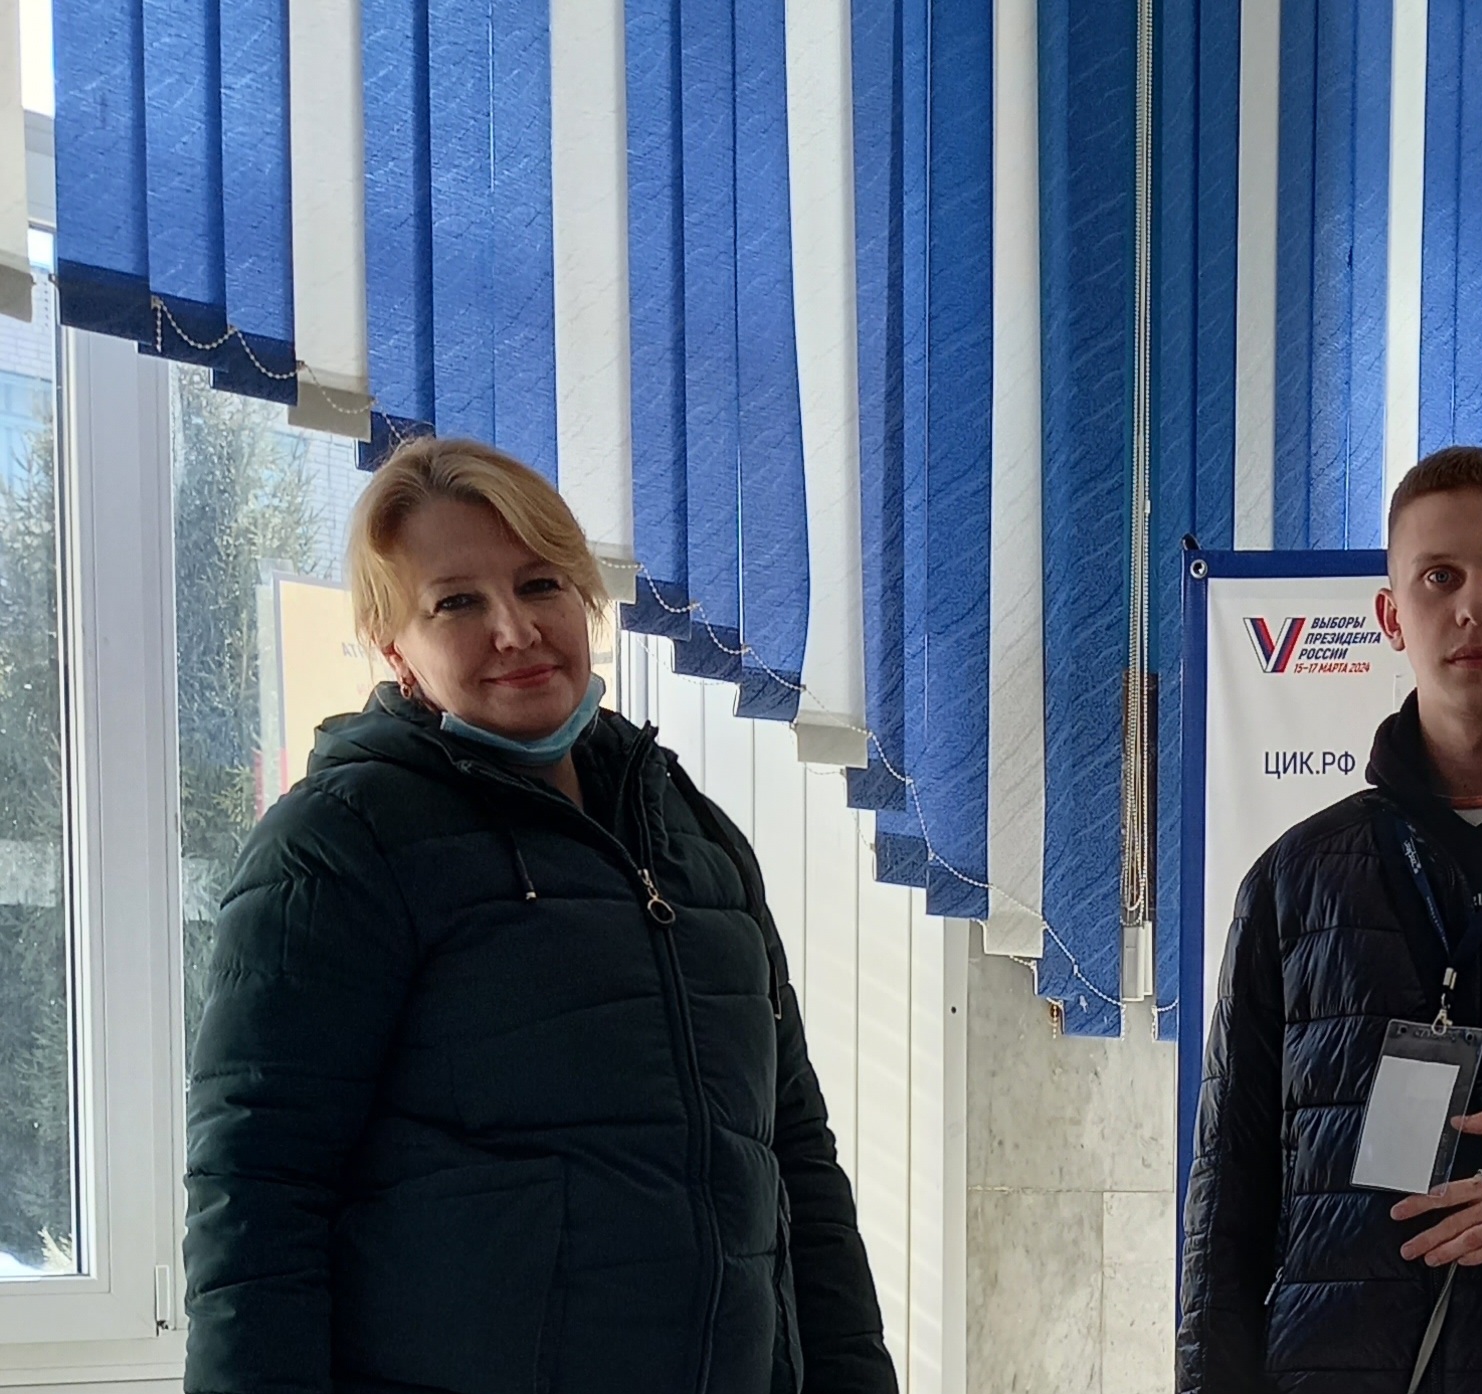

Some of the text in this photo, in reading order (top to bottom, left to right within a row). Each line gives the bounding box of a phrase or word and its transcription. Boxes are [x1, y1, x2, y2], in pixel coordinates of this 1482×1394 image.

[1311, 616, 1366, 629] ВЫБОРЫ
[1305, 632, 1381, 646] ПРЕЗИДЕНТА
[1298, 648, 1348, 660] РОССИИ
[1318, 663, 1348, 673] МАРТА
[1349, 662, 1370, 673] 2024
[1264, 751, 1356, 779] ЦИК.РФ
